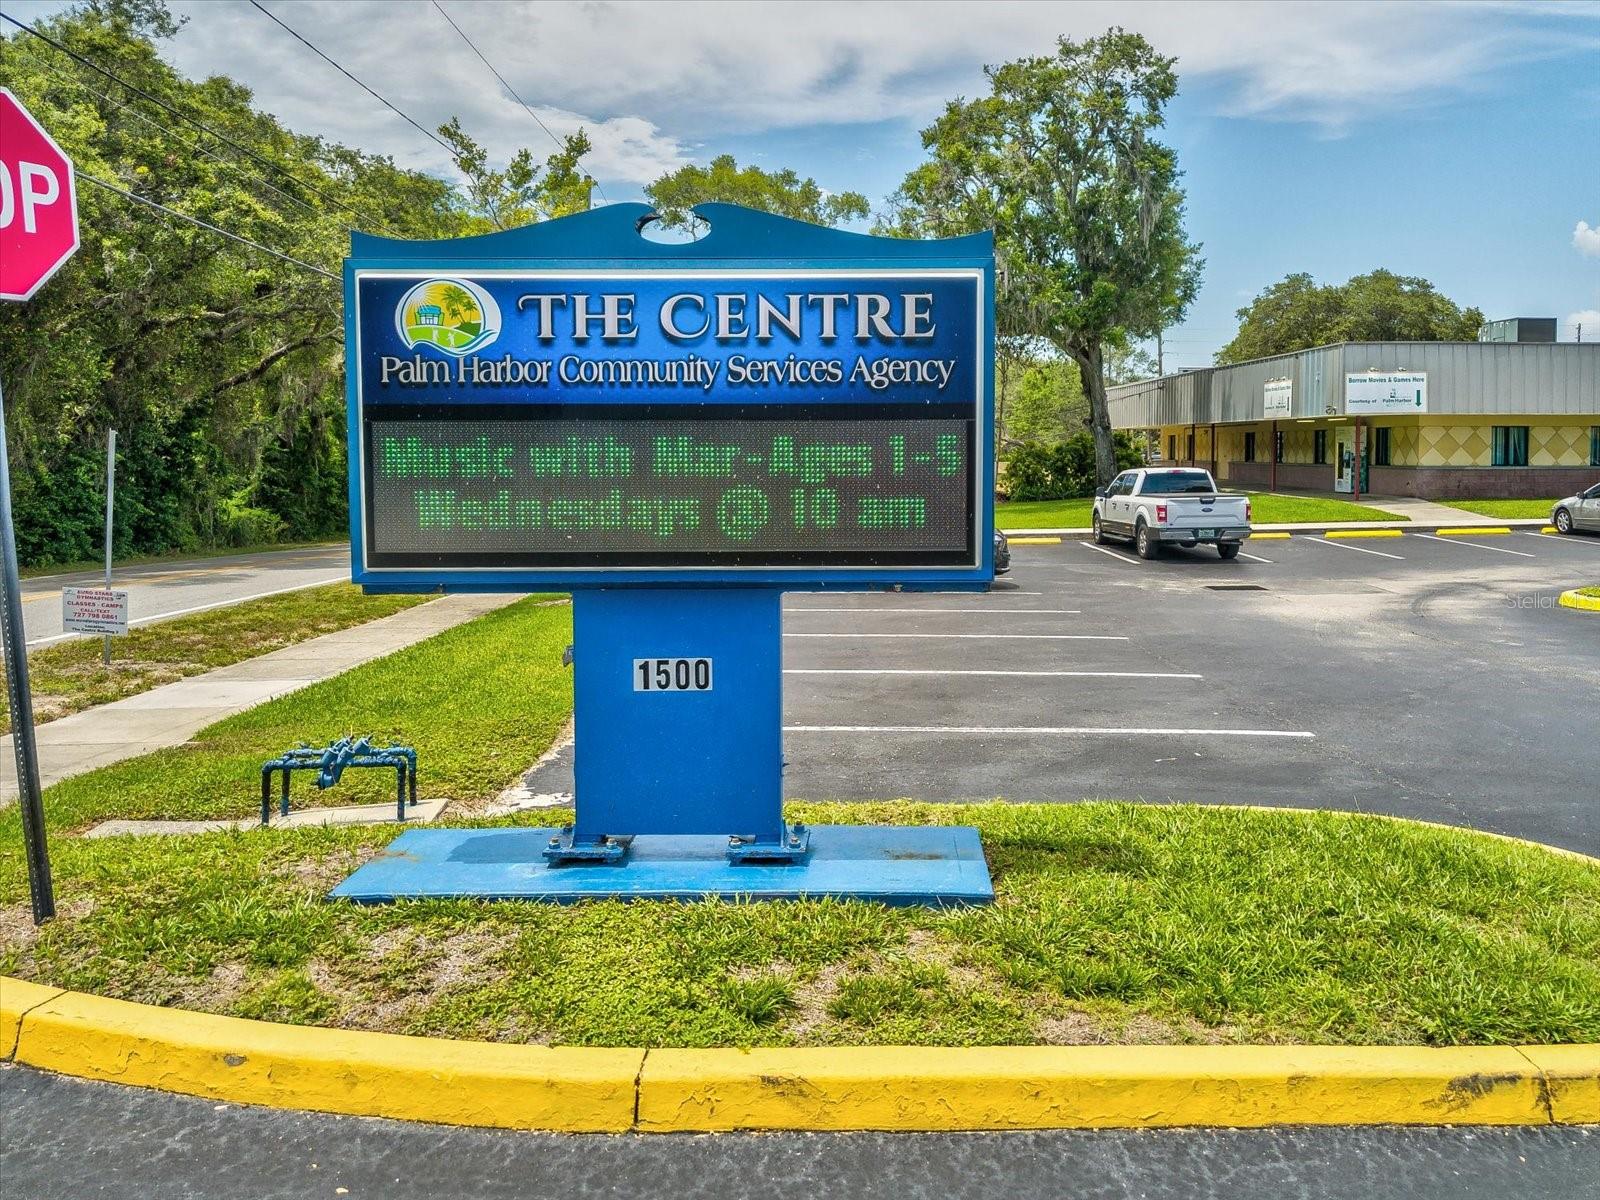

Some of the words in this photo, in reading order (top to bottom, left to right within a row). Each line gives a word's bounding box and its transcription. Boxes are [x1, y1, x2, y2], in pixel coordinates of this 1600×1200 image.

[518, 294, 639, 338] THE
[660, 293, 936, 339] CENTRE
[380, 354, 451, 383] Palm
[457, 353, 552, 383] Harbor
[559, 354, 720, 389] Community
[727, 354, 842, 383] Services
[850, 355, 955, 389] Agency
[381, 435, 514, 478] Music
[530, 435, 632, 478] with
[889, 434, 962, 477] 1-5
[414, 488, 700, 539] Wednesdays
[716, 484, 771, 541] @
[790, 487, 840, 530] 10
[857, 496, 927, 529] am
[638, 660, 709, 690] 1500
